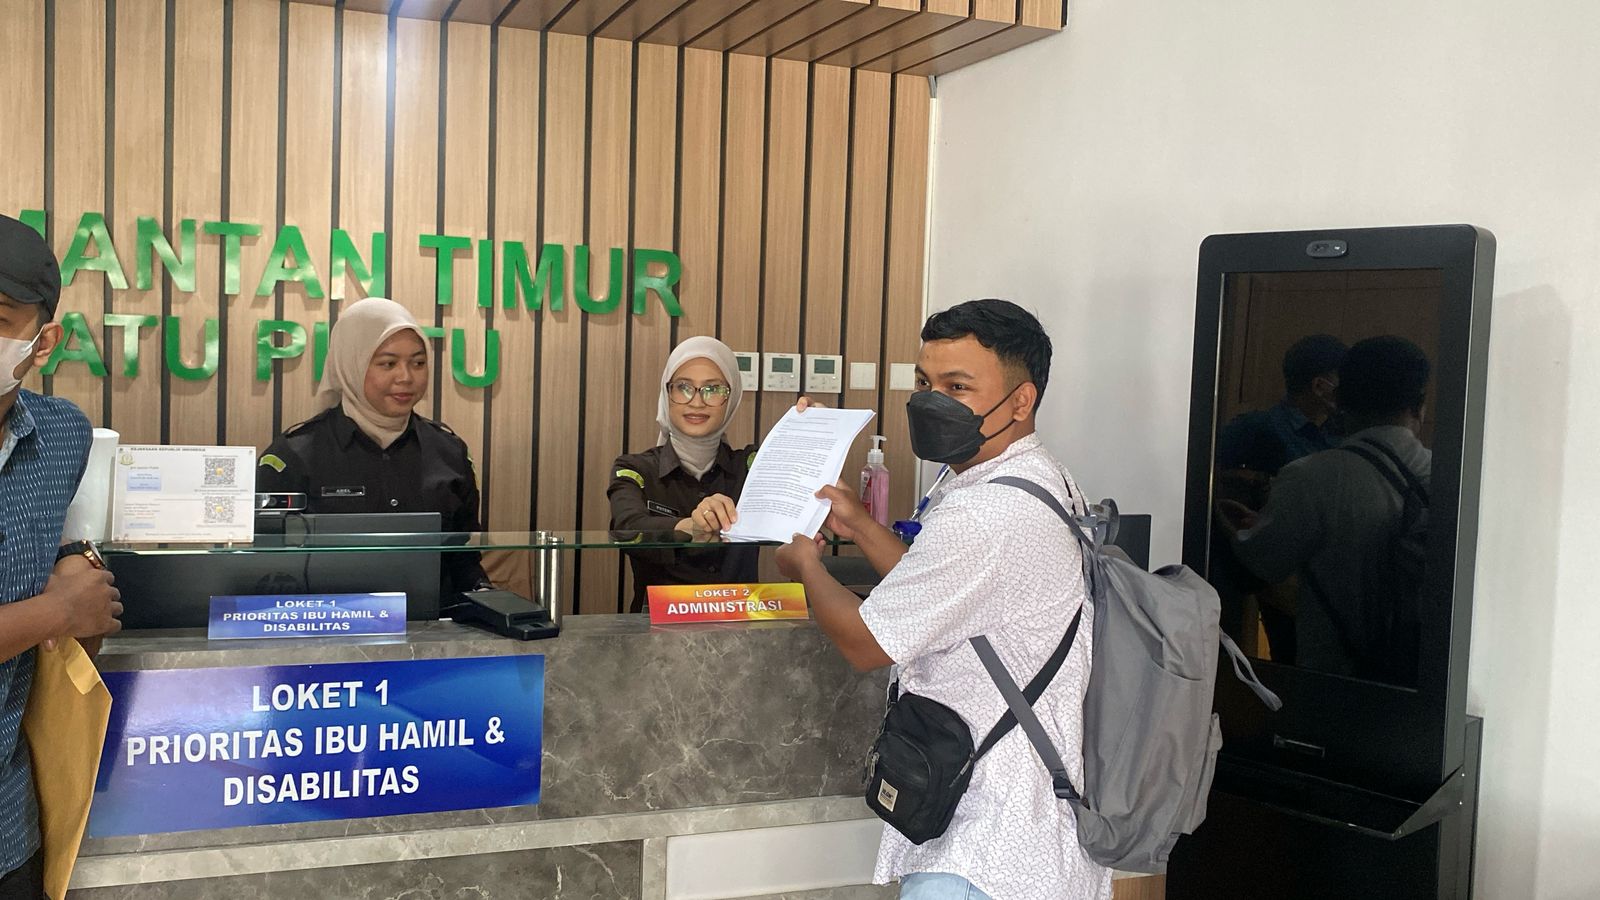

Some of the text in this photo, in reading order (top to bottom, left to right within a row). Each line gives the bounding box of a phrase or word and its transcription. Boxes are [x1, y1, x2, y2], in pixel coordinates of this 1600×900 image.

[18, 210, 685, 317] ANTAN TIMUR
[39, 311, 500, 388] ATU PIU
[276, 600, 336, 609] LOKET 1
[695, 588, 750, 598] LOKET 2
[223, 609, 389, 622] PRIORITAS IBU HAMIL &
[667, 600, 783, 615] ADMINISTRASI
[263, 622, 350, 633] DISABILITAS
[251, 679, 389, 712] LOKET 1
[126, 716, 505, 767] PRIORITAS IBU HAMIL &
[222, 765, 420, 807] DISABILITAS
